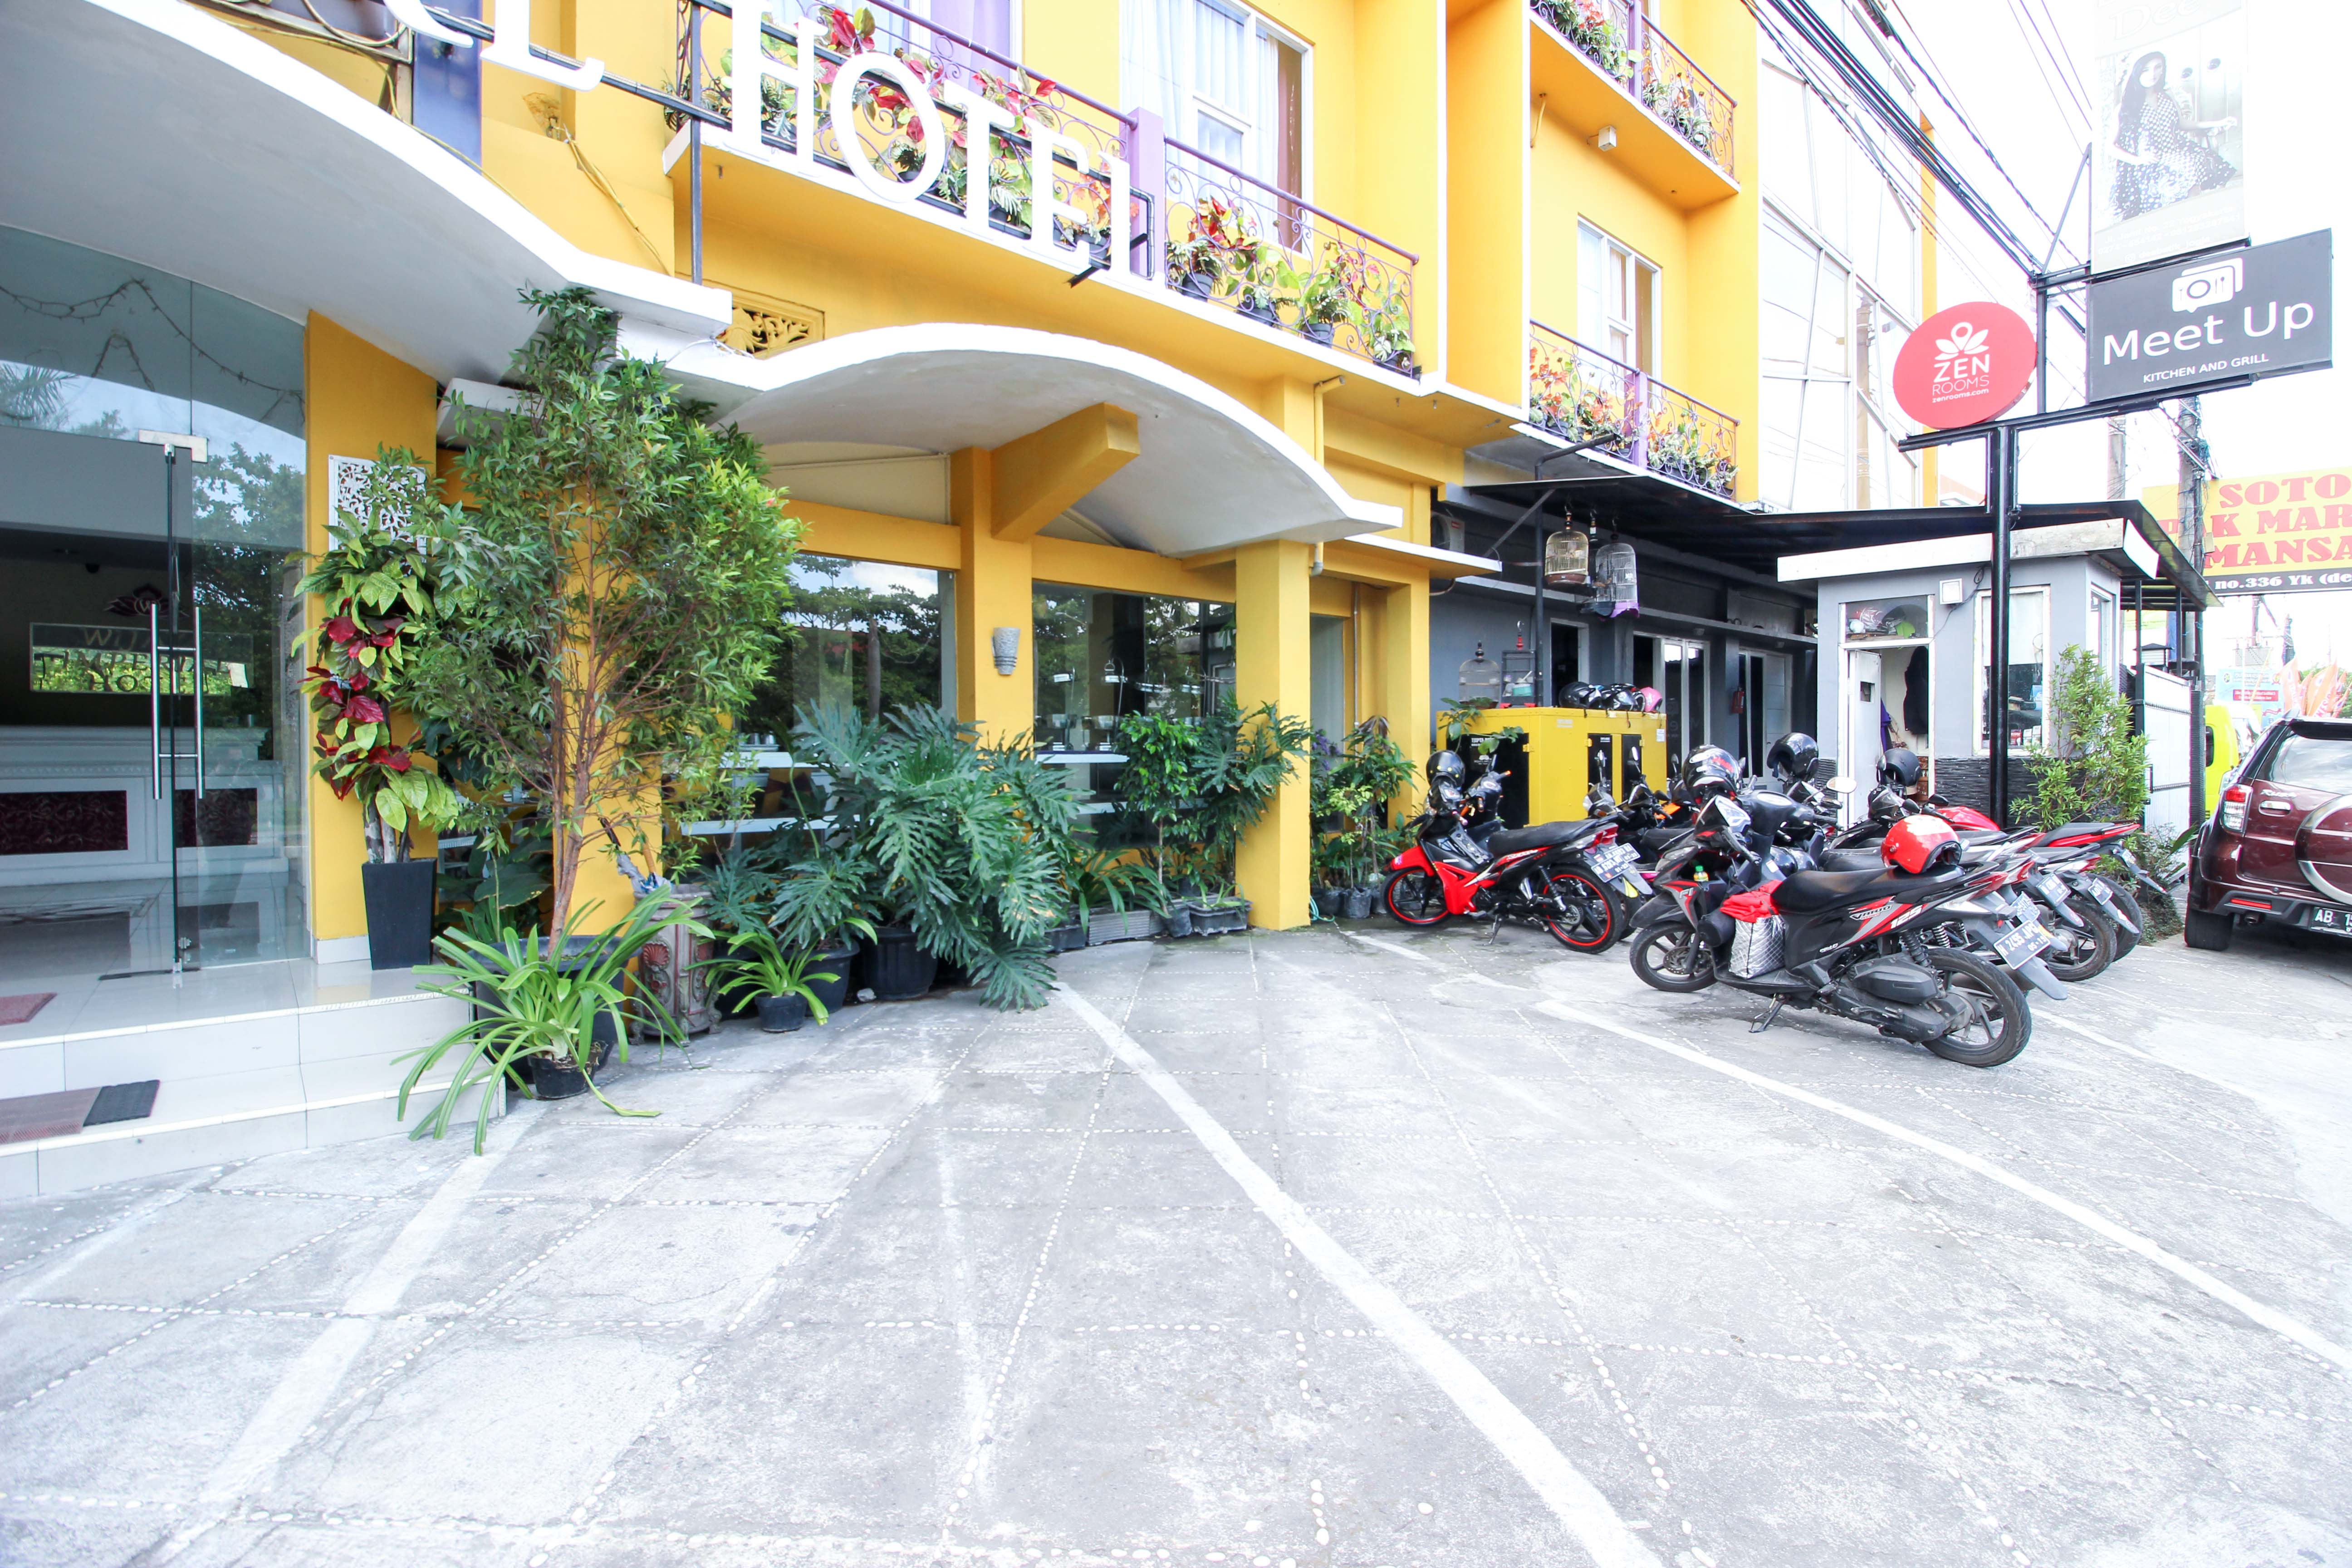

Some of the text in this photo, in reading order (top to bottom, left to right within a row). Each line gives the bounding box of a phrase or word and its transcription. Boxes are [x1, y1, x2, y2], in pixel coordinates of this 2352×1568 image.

[2103, 301, 2313, 365] Meet Up
[1933, 354, 1989, 383] ZEN
[2143, 353, 2269, 383] KITCHEN AND GRILL
[1932, 375, 1989, 396] ROOMS
[1932, 388, 1989, 403] zenrooms.com
[2220, 474, 2351, 509] SOTO
[2215, 576, 2282, 590] no.336
[2289, 574, 2313, 586] Yk
[1680, 887, 1694, 898] FI
[1891, 906, 1922, 929] 125
[2315, 908, 2332, 922] AB
